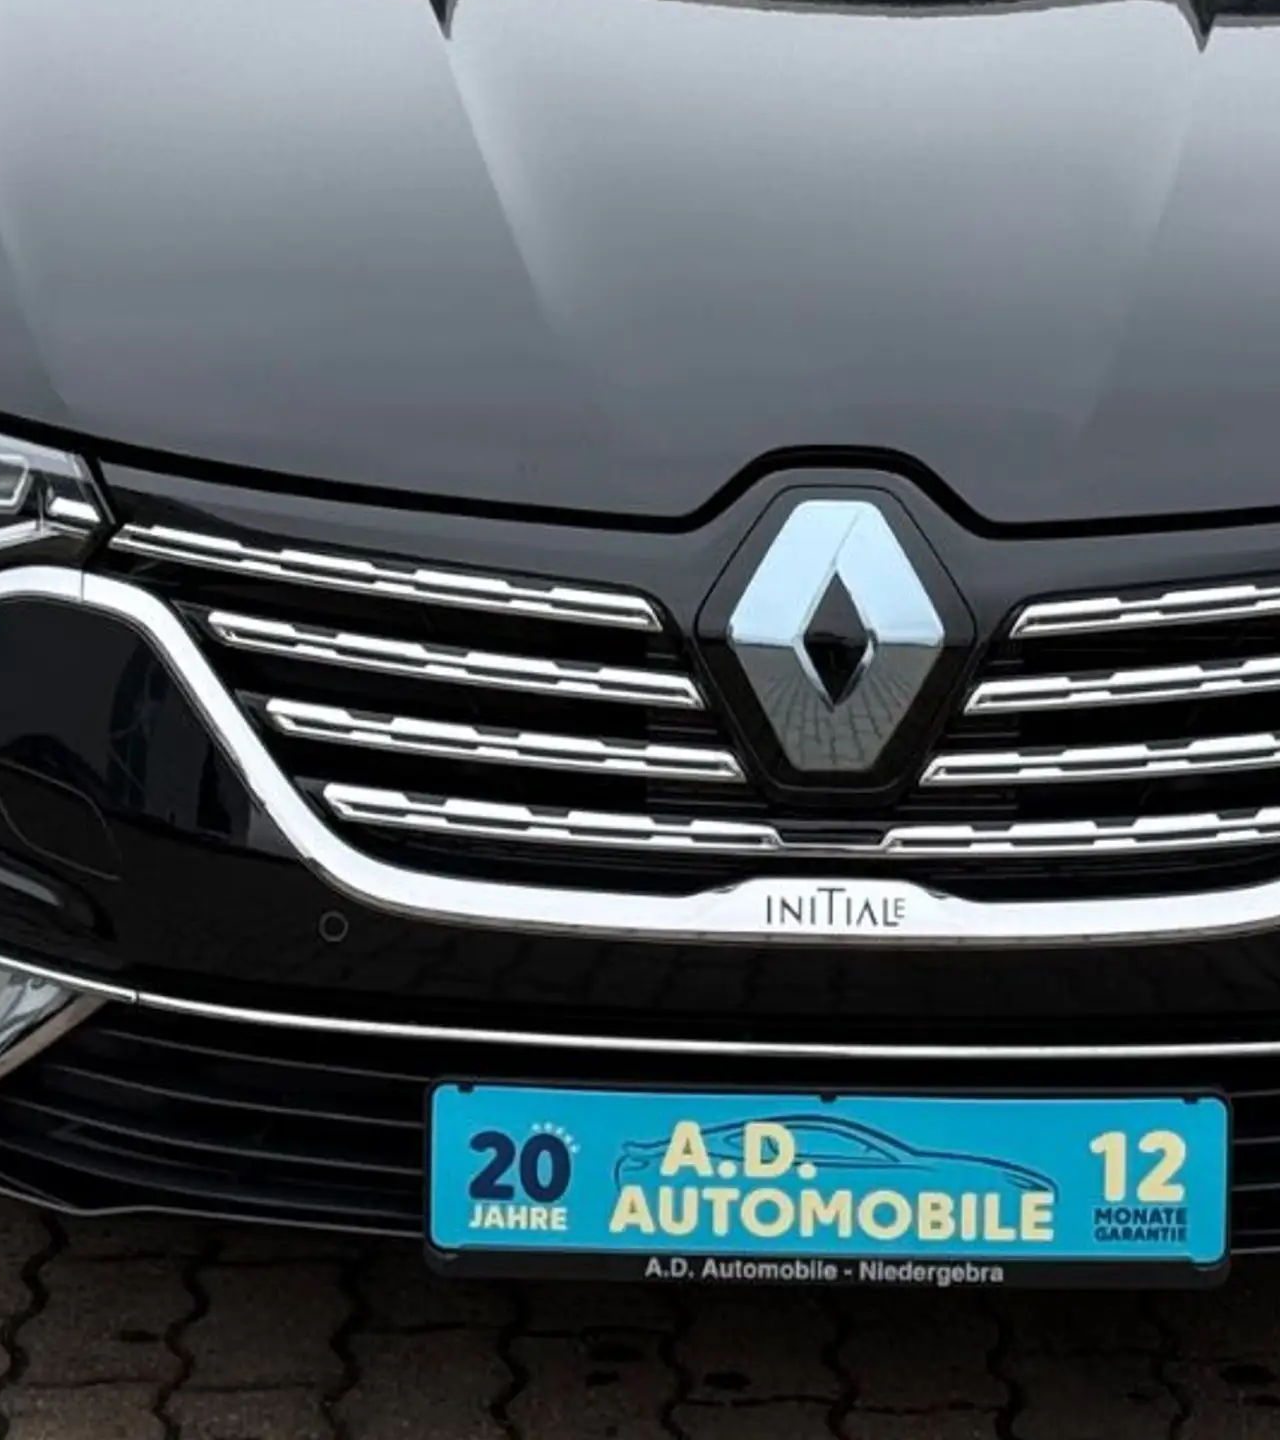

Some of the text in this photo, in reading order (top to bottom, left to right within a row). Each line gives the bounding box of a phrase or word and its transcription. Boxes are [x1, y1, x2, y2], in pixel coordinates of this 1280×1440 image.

[766, 887, 906, 927] INITIALE
[468, 1130, 572, 1203] 20
[660, 1120, 817, 1179] A.D.
[1089, 1130, 1186, 1202] 12
[468, 1203, 569, 1231] JAHRE
[609, 1184, 1055, 1242] AUTOMOBILE
[1092, 1206, 1188, 1226] MONATE
[1093, 1226, 1188, 1243] GARANTIE
[644, 1257, 694, 1278] A.D.
[701, 1258, 839, 1282] Automobile
[859, 1261, 1005, 1287] Niedergebra
